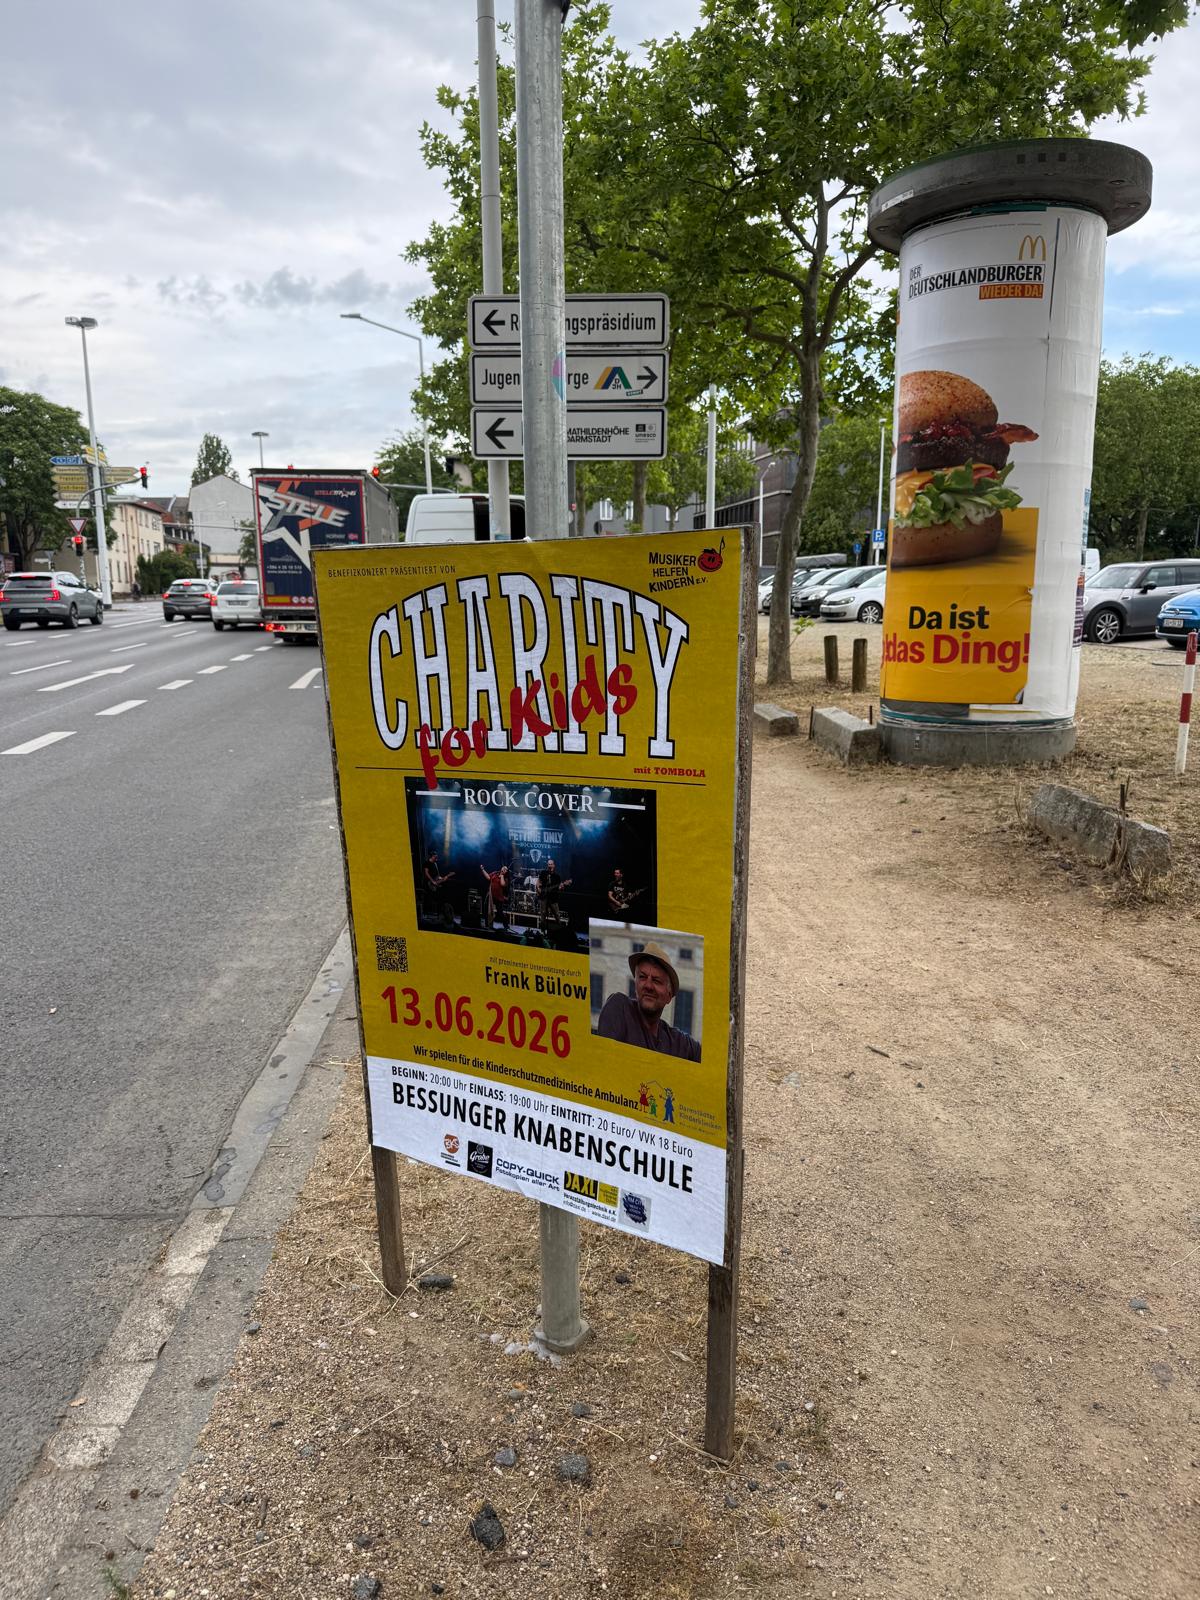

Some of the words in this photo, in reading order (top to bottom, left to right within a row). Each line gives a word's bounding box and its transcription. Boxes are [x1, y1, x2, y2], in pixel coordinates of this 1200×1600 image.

[909, 265, 922, 281] DER
[909, 265, 1043, 299] DEUTSCHLANDBURGER
[981, 284, 1022, 298] WIEDER
[1024, 284, 1043, 298] DA!
[510, 312, 656, 335] Rngspräsidium
[481, 368, 589, 389] Jugenrge
[263, 491, 351, 527] STELE
[328, 567, 387, 578] BENEFIZKONZERT
[390, 565, 437, 575] PRÄSENTIERT
[439, 565, 456, 574] VON
[648, 551, 697, 567] MUSIKER
[652, 566, 689, 577] HELFEN
[648, 575, 695, 593] KINDERN
[908, 606, 942, 629] Da
[949, 603, 990, 629] ist
[885, 632, 925, 664] das
[932, 631, 1030, 673] Ding!
[368, 572, 689, 759] CHARITY
[419, 717, 487, 790] for
[633, 766, 650, 774] mit
[653, 767, 706, 778] TOMBOLA
[463, 787, 520, 808] ROCK
[523, 790, 595, 813] COVER
[542, 831, 563, 844] ONLY
[485, 966, 530, 990] Frank
[534, 974, 588, 1000] Bülow
[381, 985, 571, 1058] 13.06.2026
[413, 1045, 428, 1056] Wir
[429, 1049, 458, 1063] spielen
[458, 1054, 470, 1066] für
[472, 1058, 484, 1069] die
[486, 1060, 593, 1097] Kinderschutzmedizinische
[594, 1088, 640, 1110] Ambulanz
[391, 1065, 429, 1082] BEGINN:
[430, 1072, 451, 1087] 20:00
[453, 1078, 468, 1091] Uhr
[469, 1082, 506, 1103] EINLASS:
[509, 1093, 531, 1109] 19:00
[533, 1100, 549, 1114] Uhr
[551, 1104, 596, 1129] EINTRITT:
[597, 1117, 609, 1131] 20
[611, 1122, 636, 1139] Euro/
[638, 1129, 656, 1146] VVK
[659, 1137, 670, 1150] 18
[672, 1142, 693, 1158] Euro
[392, 1081, 507, 1135] BESSUNGER
[513, 1112, 694, 1194] KNABENSCHULE
[495, 1166, 530, 1183] Fotokopien
